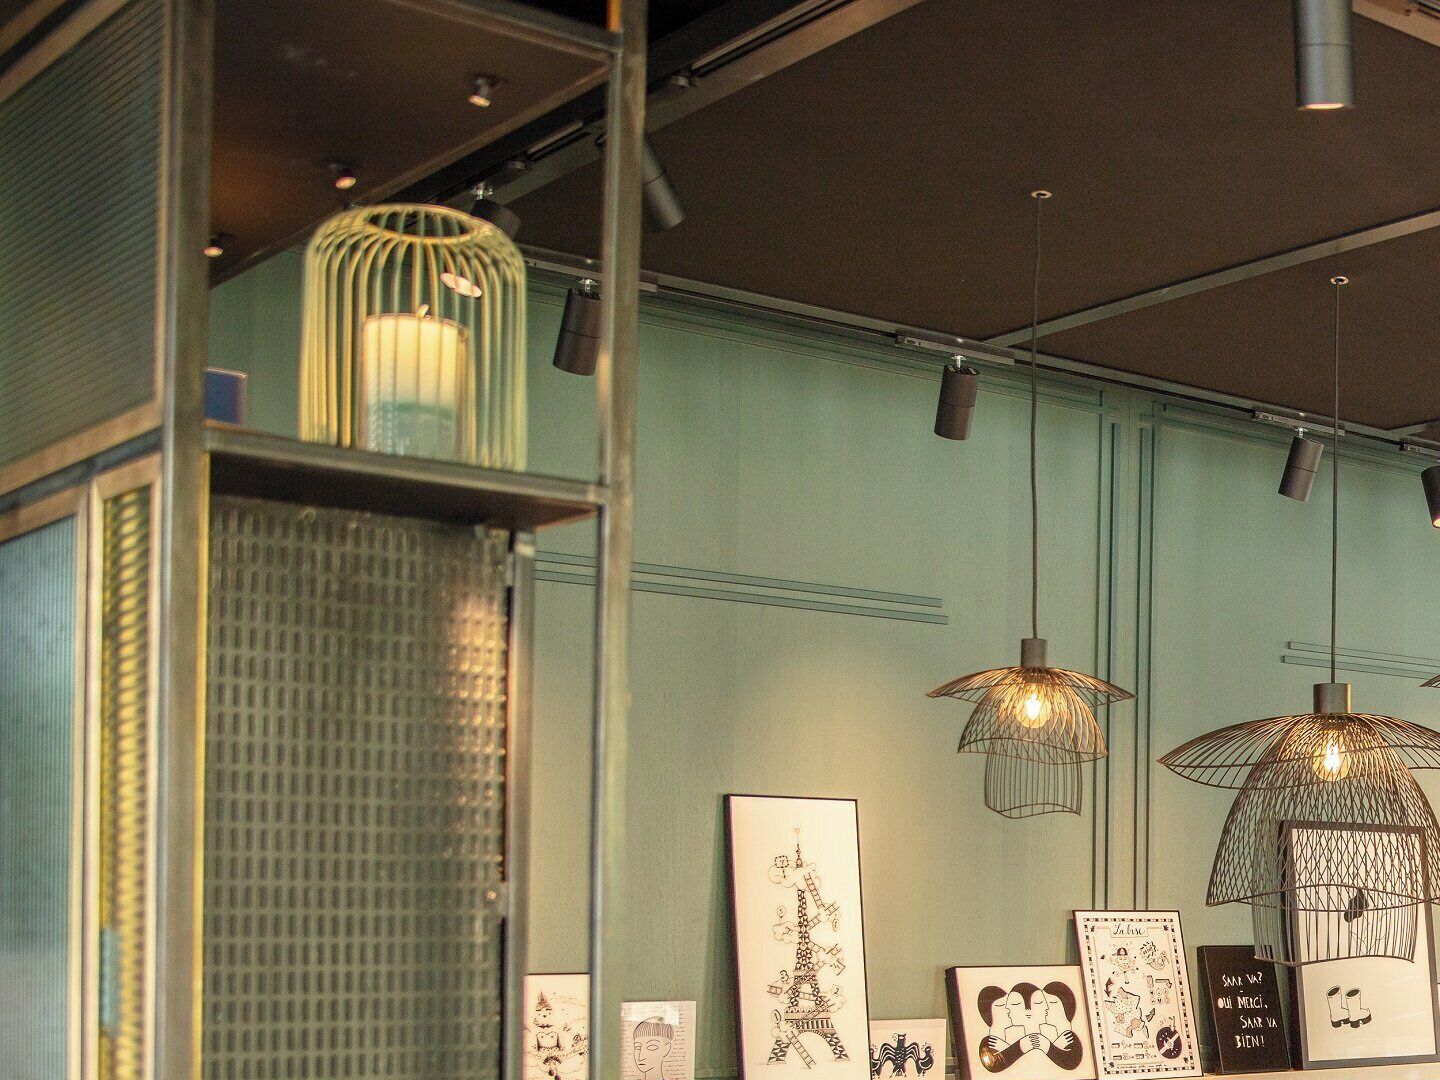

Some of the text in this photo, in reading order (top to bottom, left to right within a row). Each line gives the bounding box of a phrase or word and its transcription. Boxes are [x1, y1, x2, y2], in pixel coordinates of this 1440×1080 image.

[1222, 971, 1263, 987] SAAR VA?
[1239, 1015, 1278, 1029] SAAR VA
